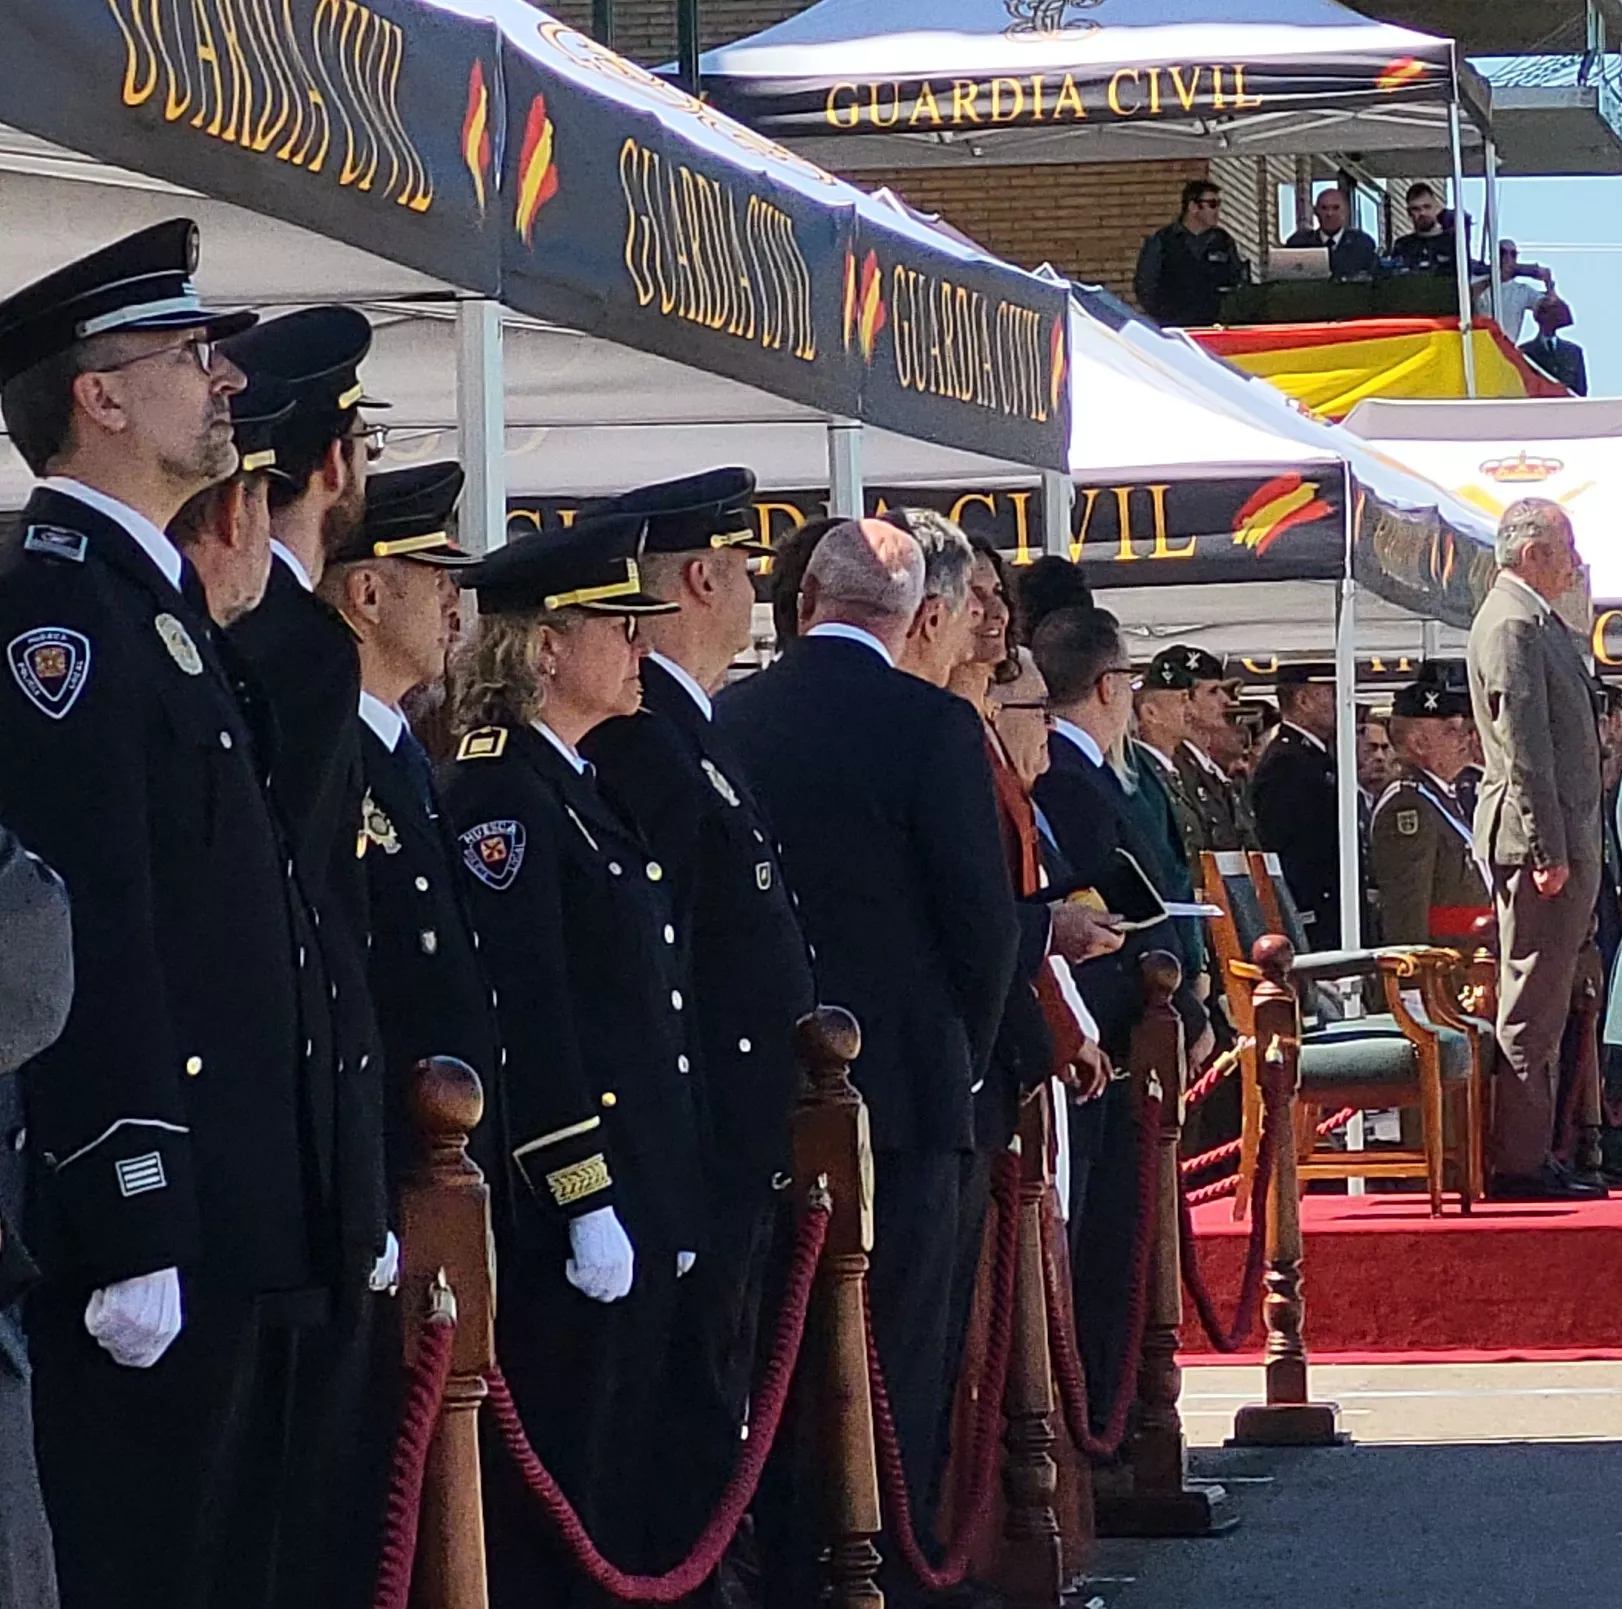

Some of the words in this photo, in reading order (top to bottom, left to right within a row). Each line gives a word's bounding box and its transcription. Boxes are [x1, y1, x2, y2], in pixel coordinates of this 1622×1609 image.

[313, 0, 433, 212] CIVIL
[826, 72, 1088, 129] GUARDIA
[1107, 63, 1264, 117] CIVIL
[620, 138, 755, 340] GUARDIA
[746, 194, 817, 361] CIVIL
[893, 264, 997, 409] GUARDIA
[997, 300, 1048, 422] CIVIL
